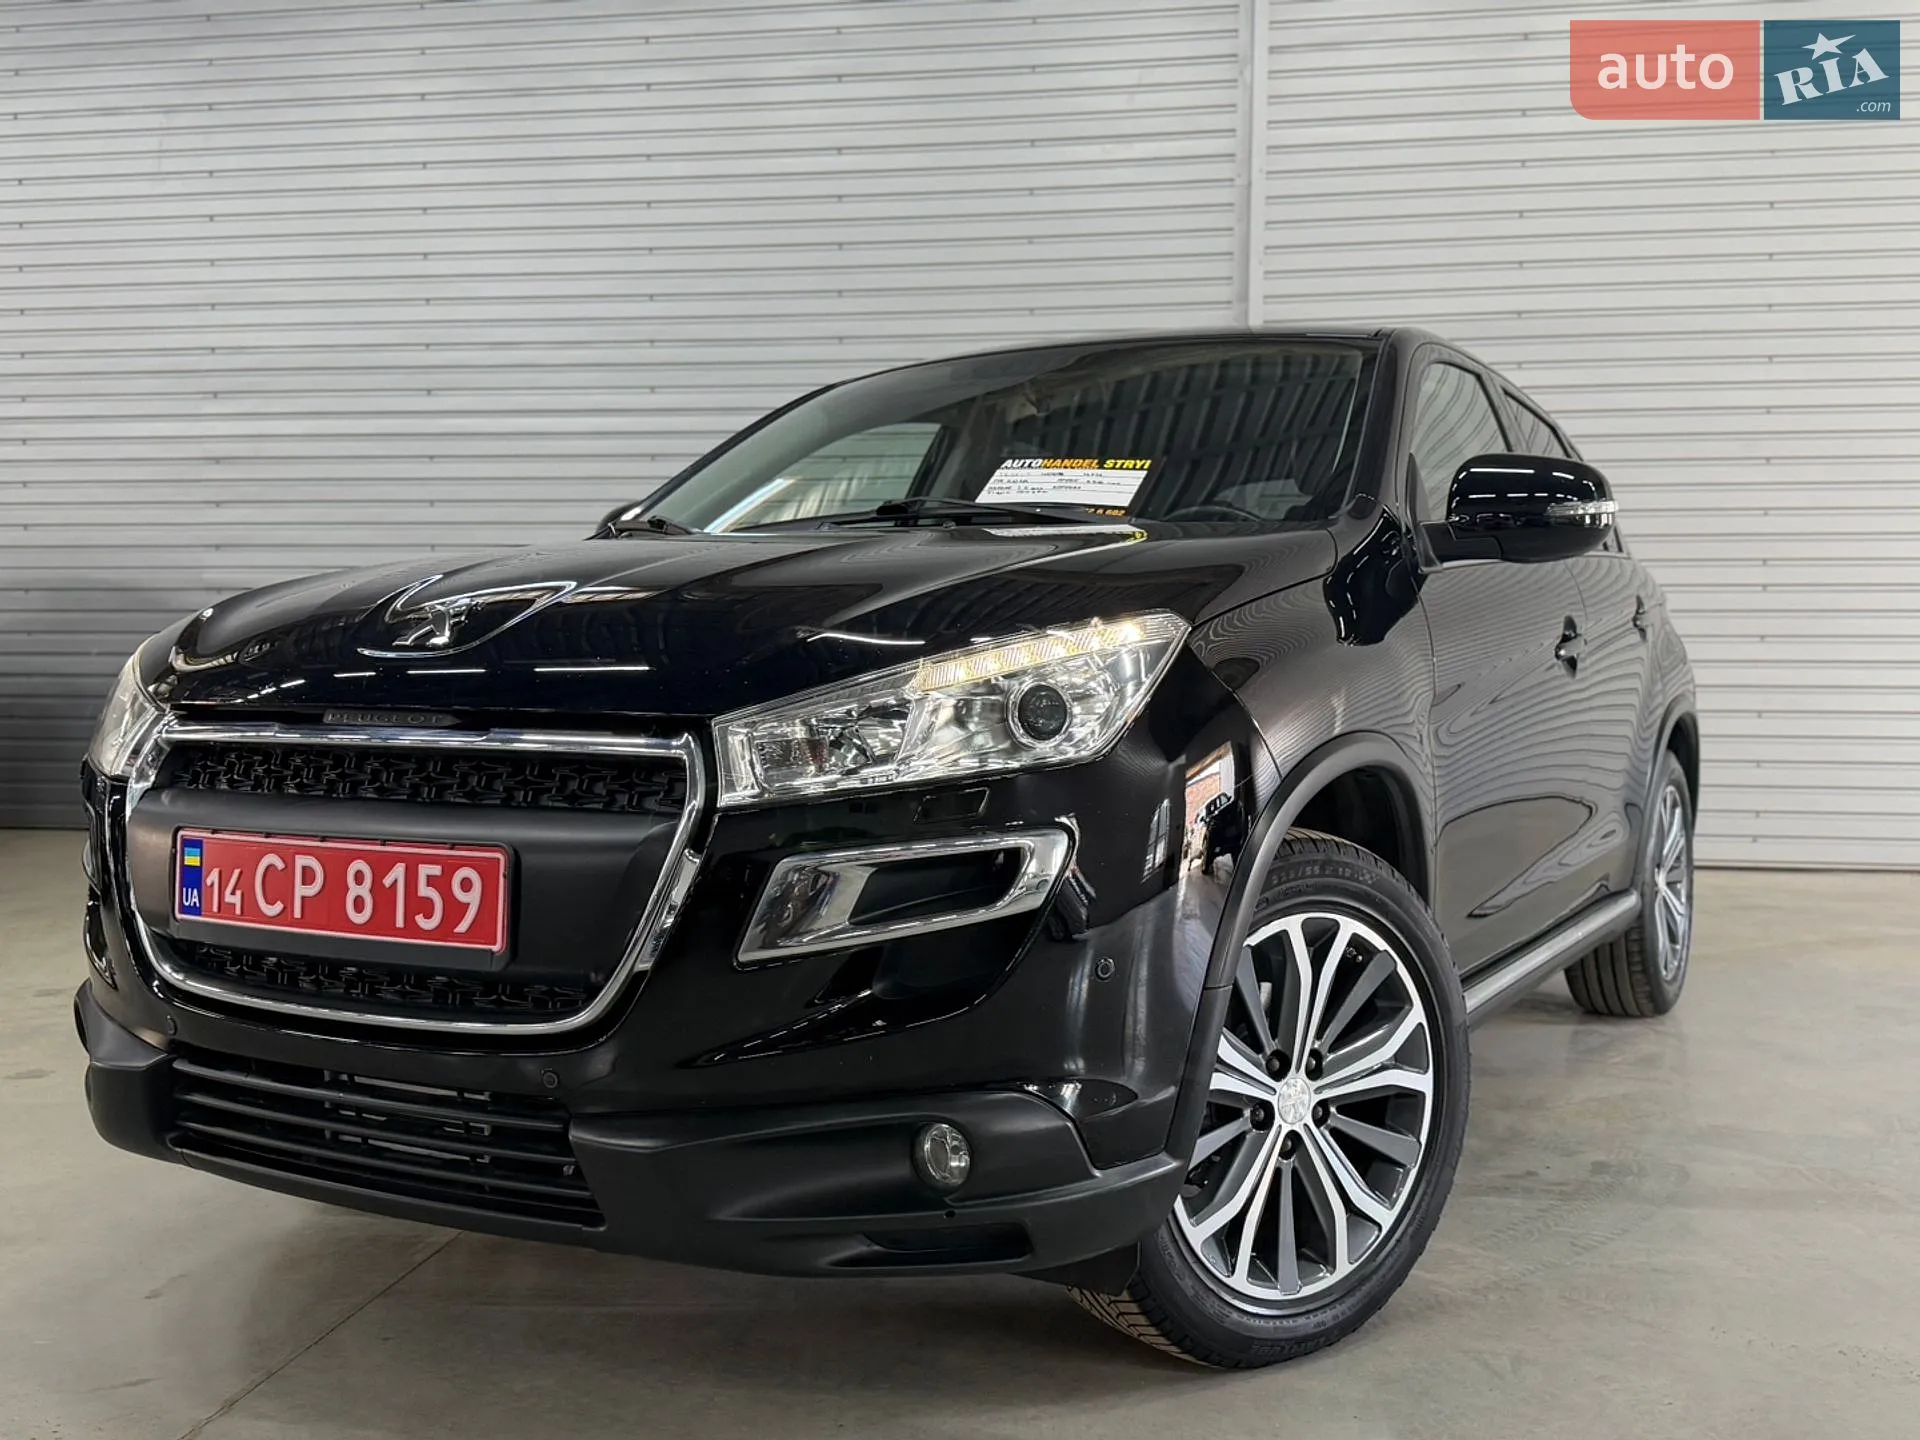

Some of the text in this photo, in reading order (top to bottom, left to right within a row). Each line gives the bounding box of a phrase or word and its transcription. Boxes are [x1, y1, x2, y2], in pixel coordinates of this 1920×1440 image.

[1000, 458, 1152, 470] AUTOHANDEL STRYI
[182, 886, 200, 908] UA
[205, 853, 483, 934] 14 CP 8159
